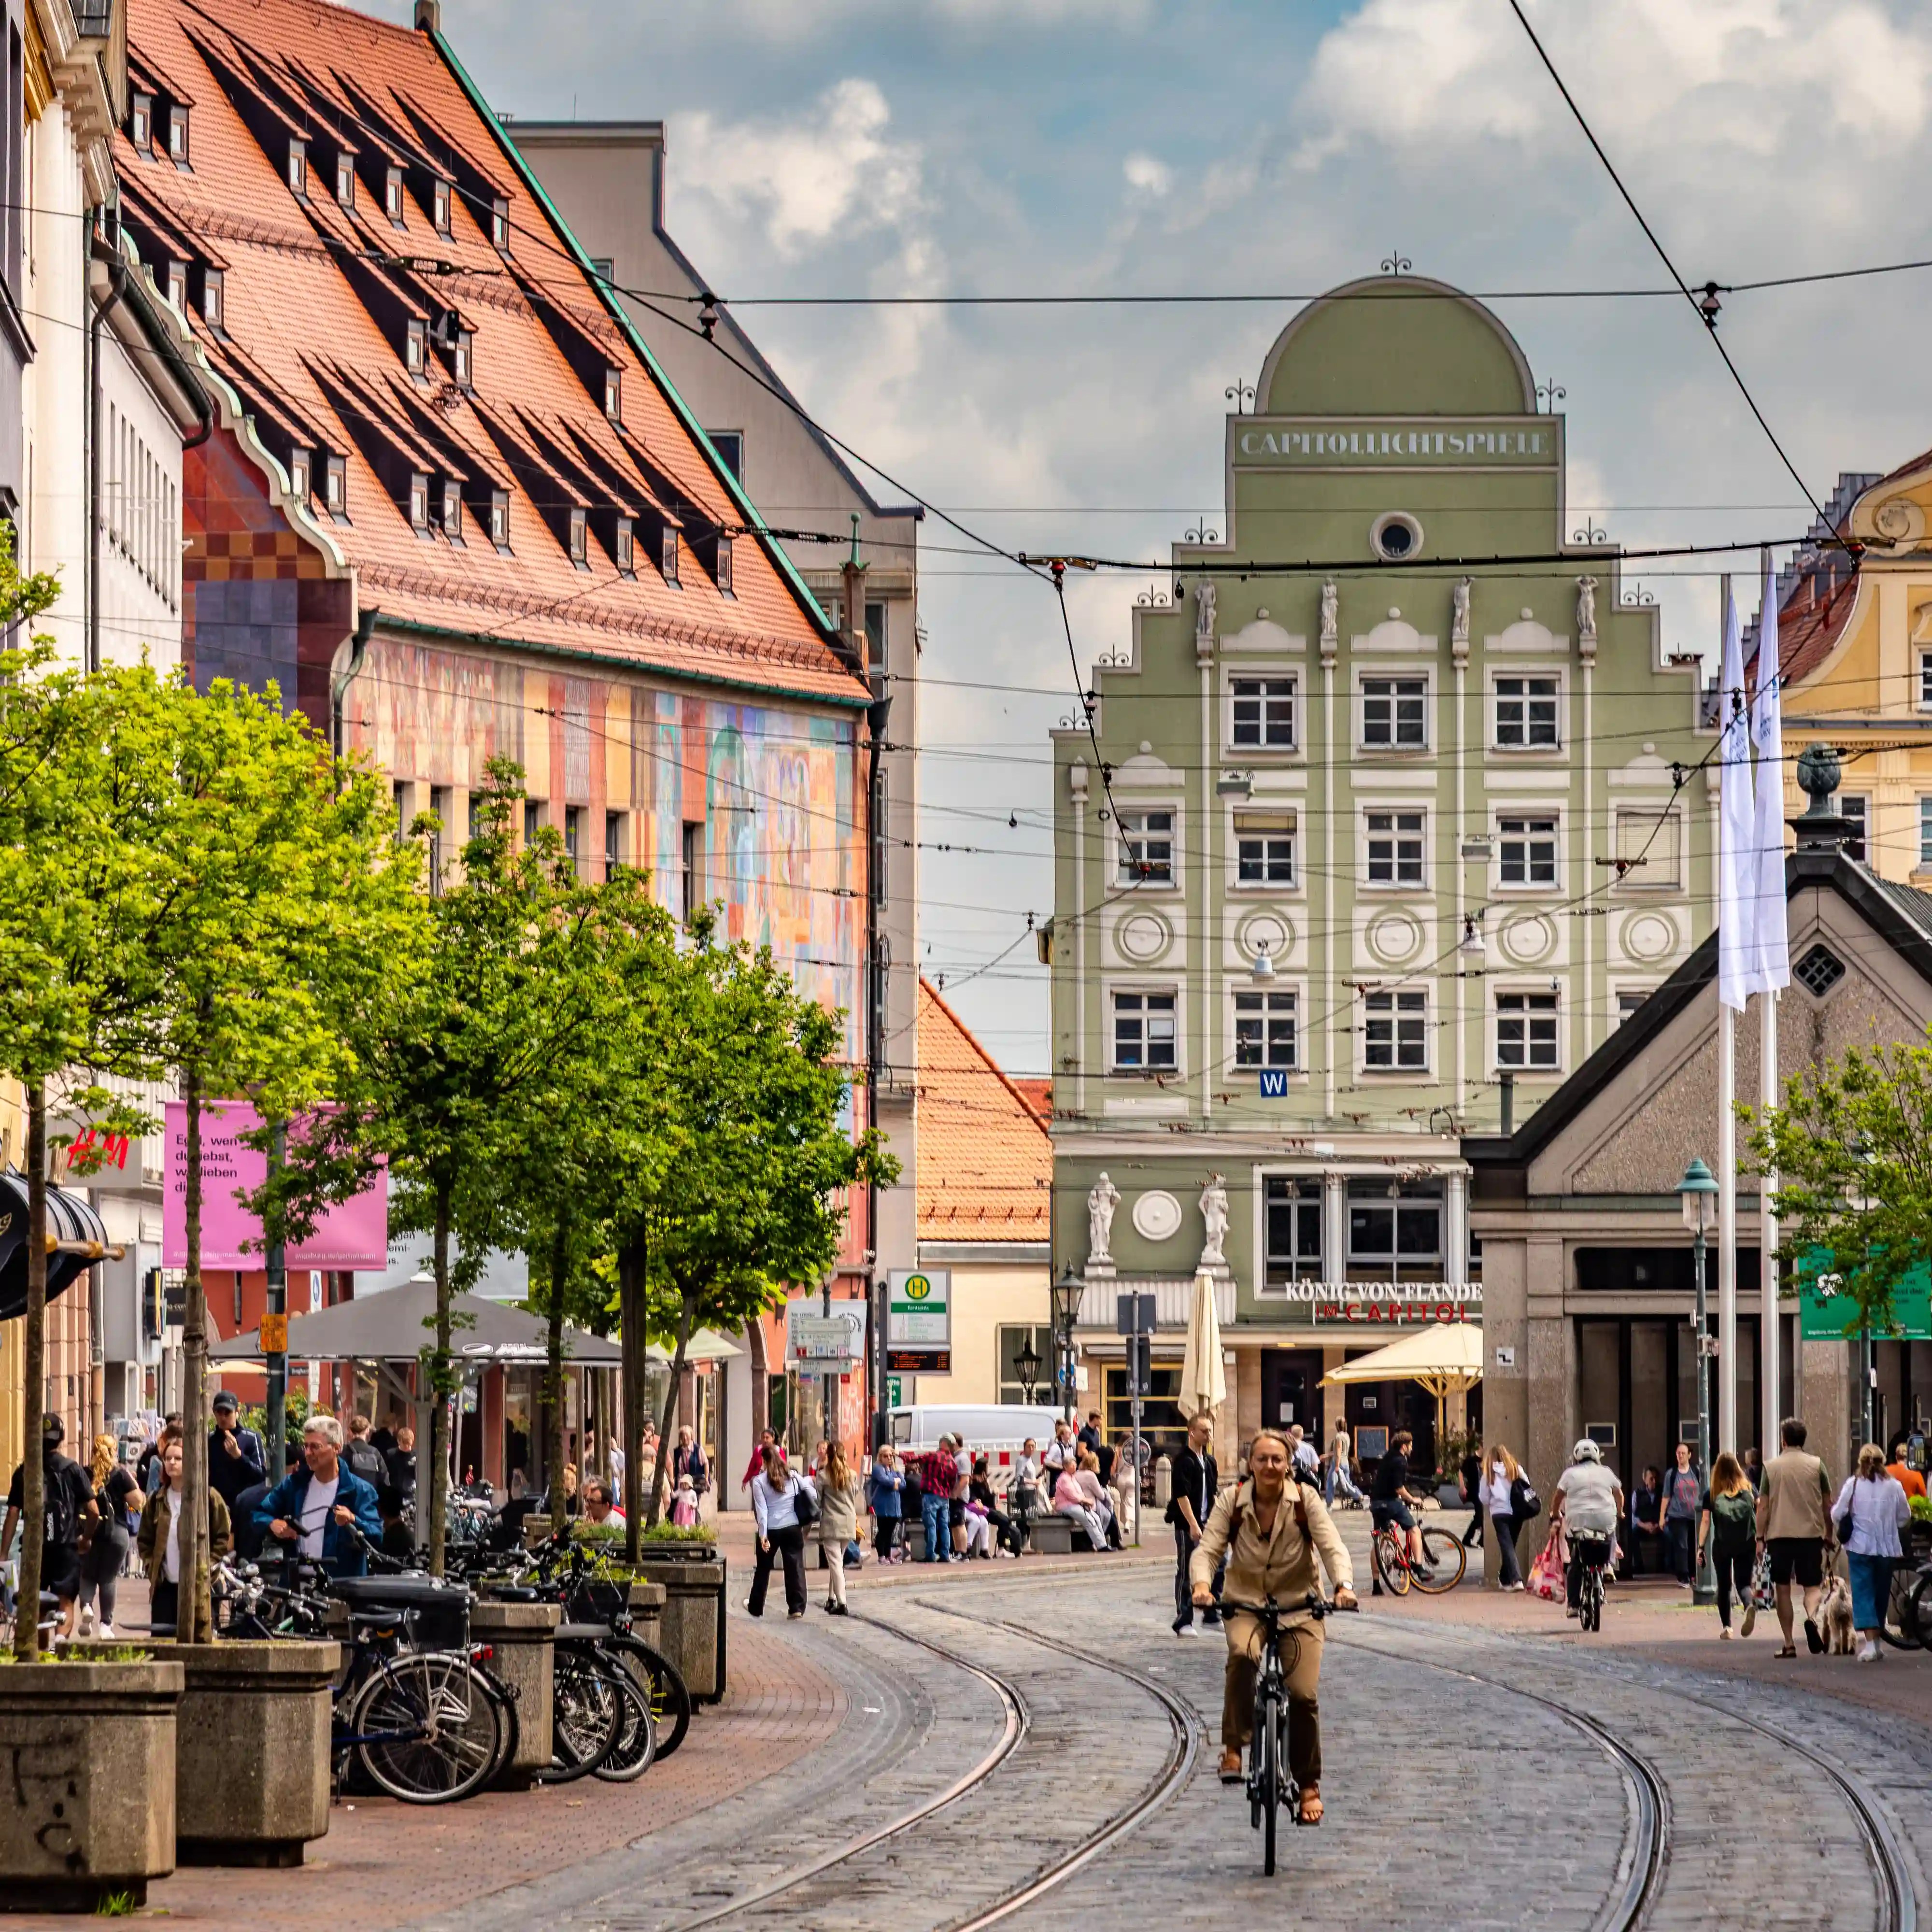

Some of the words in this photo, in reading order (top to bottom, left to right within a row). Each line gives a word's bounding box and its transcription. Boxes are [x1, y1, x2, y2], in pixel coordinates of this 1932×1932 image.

[1240, 431, 1548, 455] CAPITOLLICHTSPIELE
[1263, 1073, 1284, 1094] W
[1285, 1278, 1351, 1302] KÖNIG
[1356, 1282, 1399, 1301] VON
[1315, 1304, 1338, 1318] IM
[1346, 1303, 1472, 1322] CAPITOL
